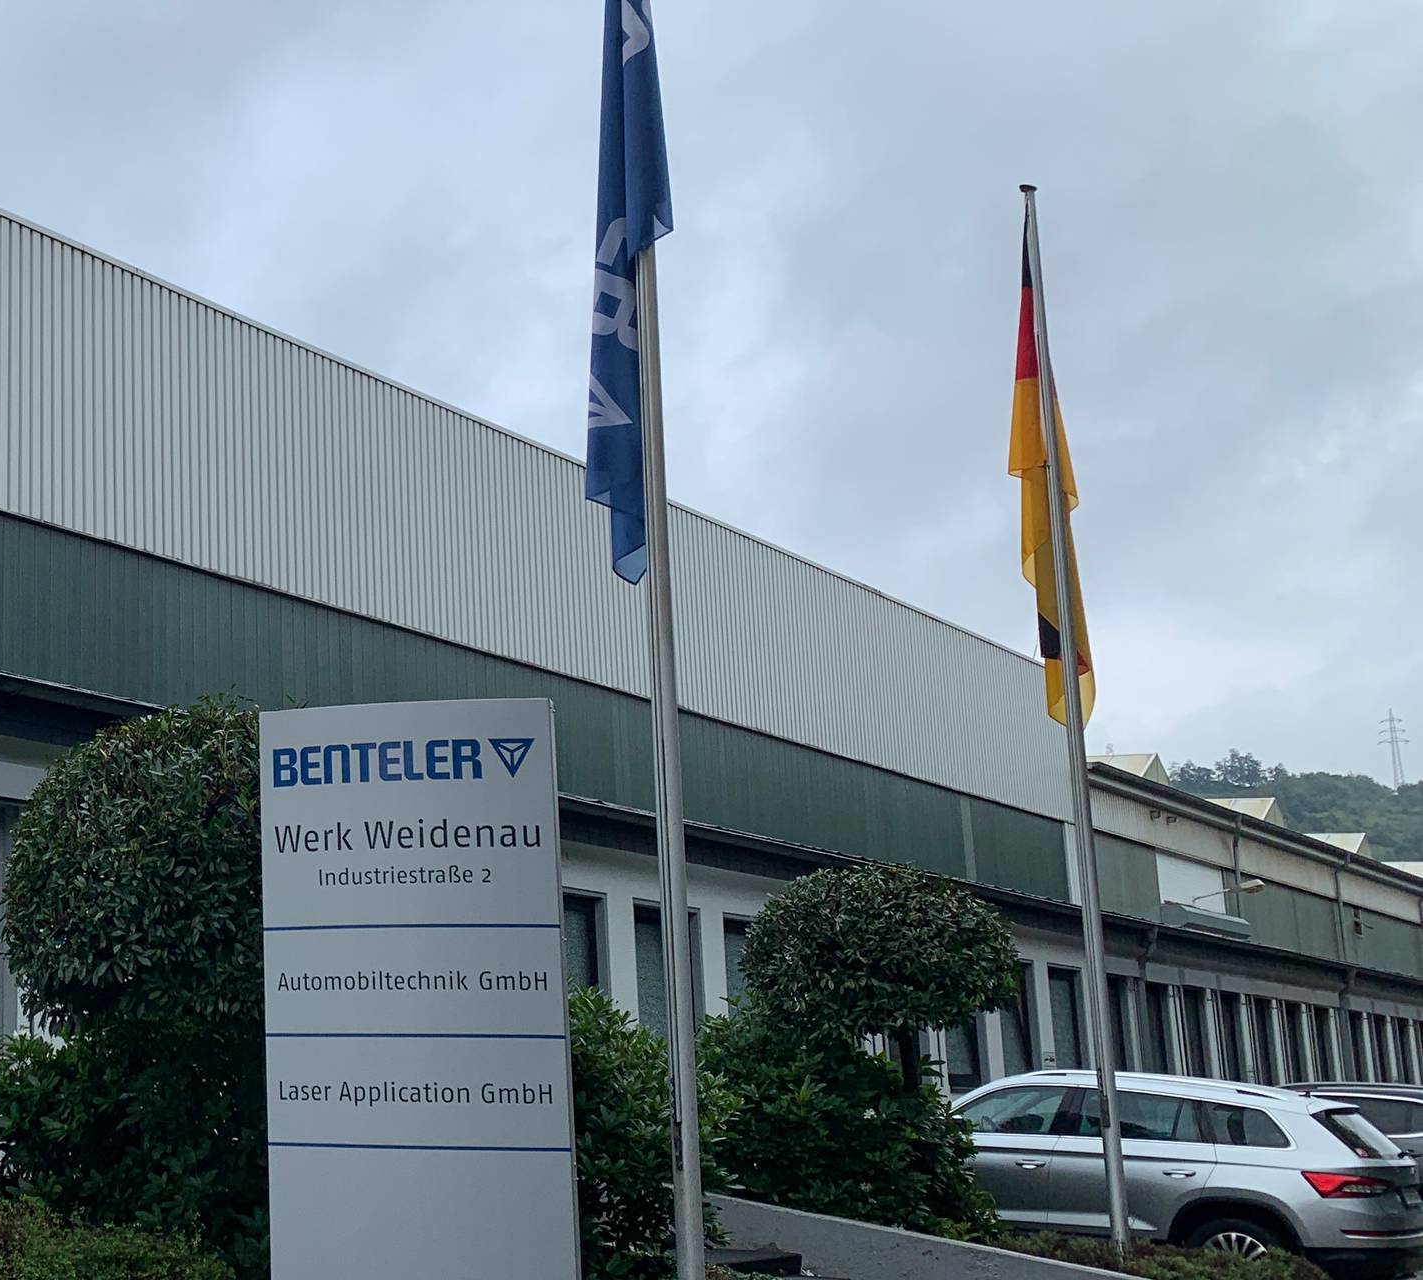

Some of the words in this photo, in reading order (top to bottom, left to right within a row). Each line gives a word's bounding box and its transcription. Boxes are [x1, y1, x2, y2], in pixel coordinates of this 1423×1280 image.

[272, 738, 483, 788] BENTELER
[274, 822, 353, 854] Werk
[364, 818, 542, 850] Weidenau
[318, 865, 473, 887] Industriestraße
[481, 868, 492, 884] 2
[277, 971, 469, 992] Automobiltechnik
[479, 970, 549, 992] GmbH
[279, 1081, 332, 1102] Laser
[339, 1081, 470, 1107] Application
[481, 1083, 553, 1105] GmbH
